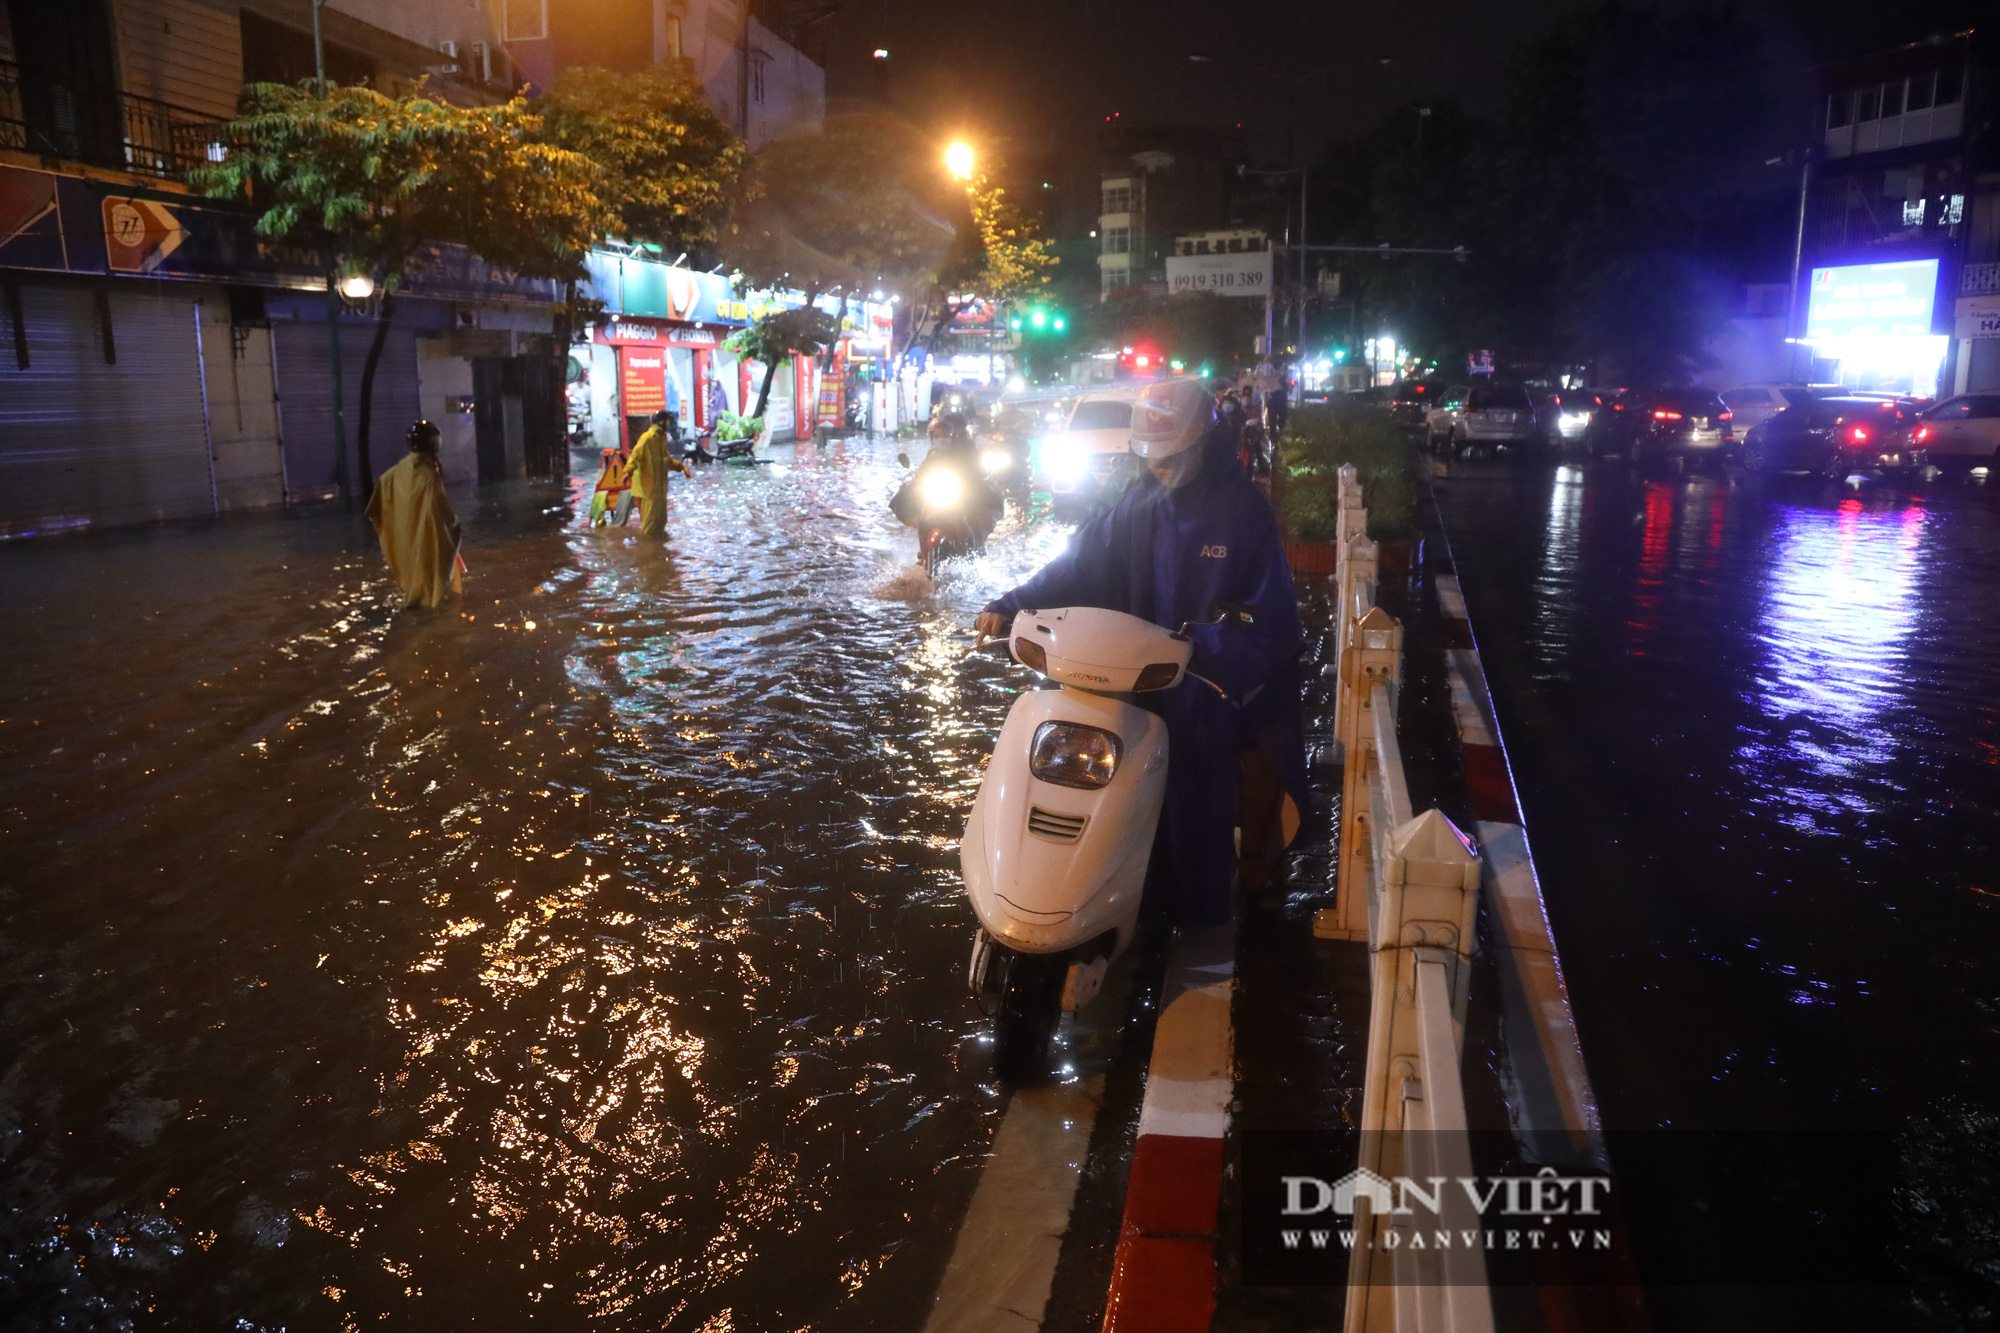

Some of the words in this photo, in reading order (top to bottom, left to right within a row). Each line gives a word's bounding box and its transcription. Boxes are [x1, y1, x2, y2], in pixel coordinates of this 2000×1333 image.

[1174, 274, 1206, 289] 0919
[1210, 272, 1234, 287] 310
[1237, 271, 1263, 286] 389
[616, 323, 658, 341] PIAGGIO
[681, 328, 716, 344] HONDA
[1200, 544, 1228, 558] ACB
[1068, 671, 1111, 684] HONDA
